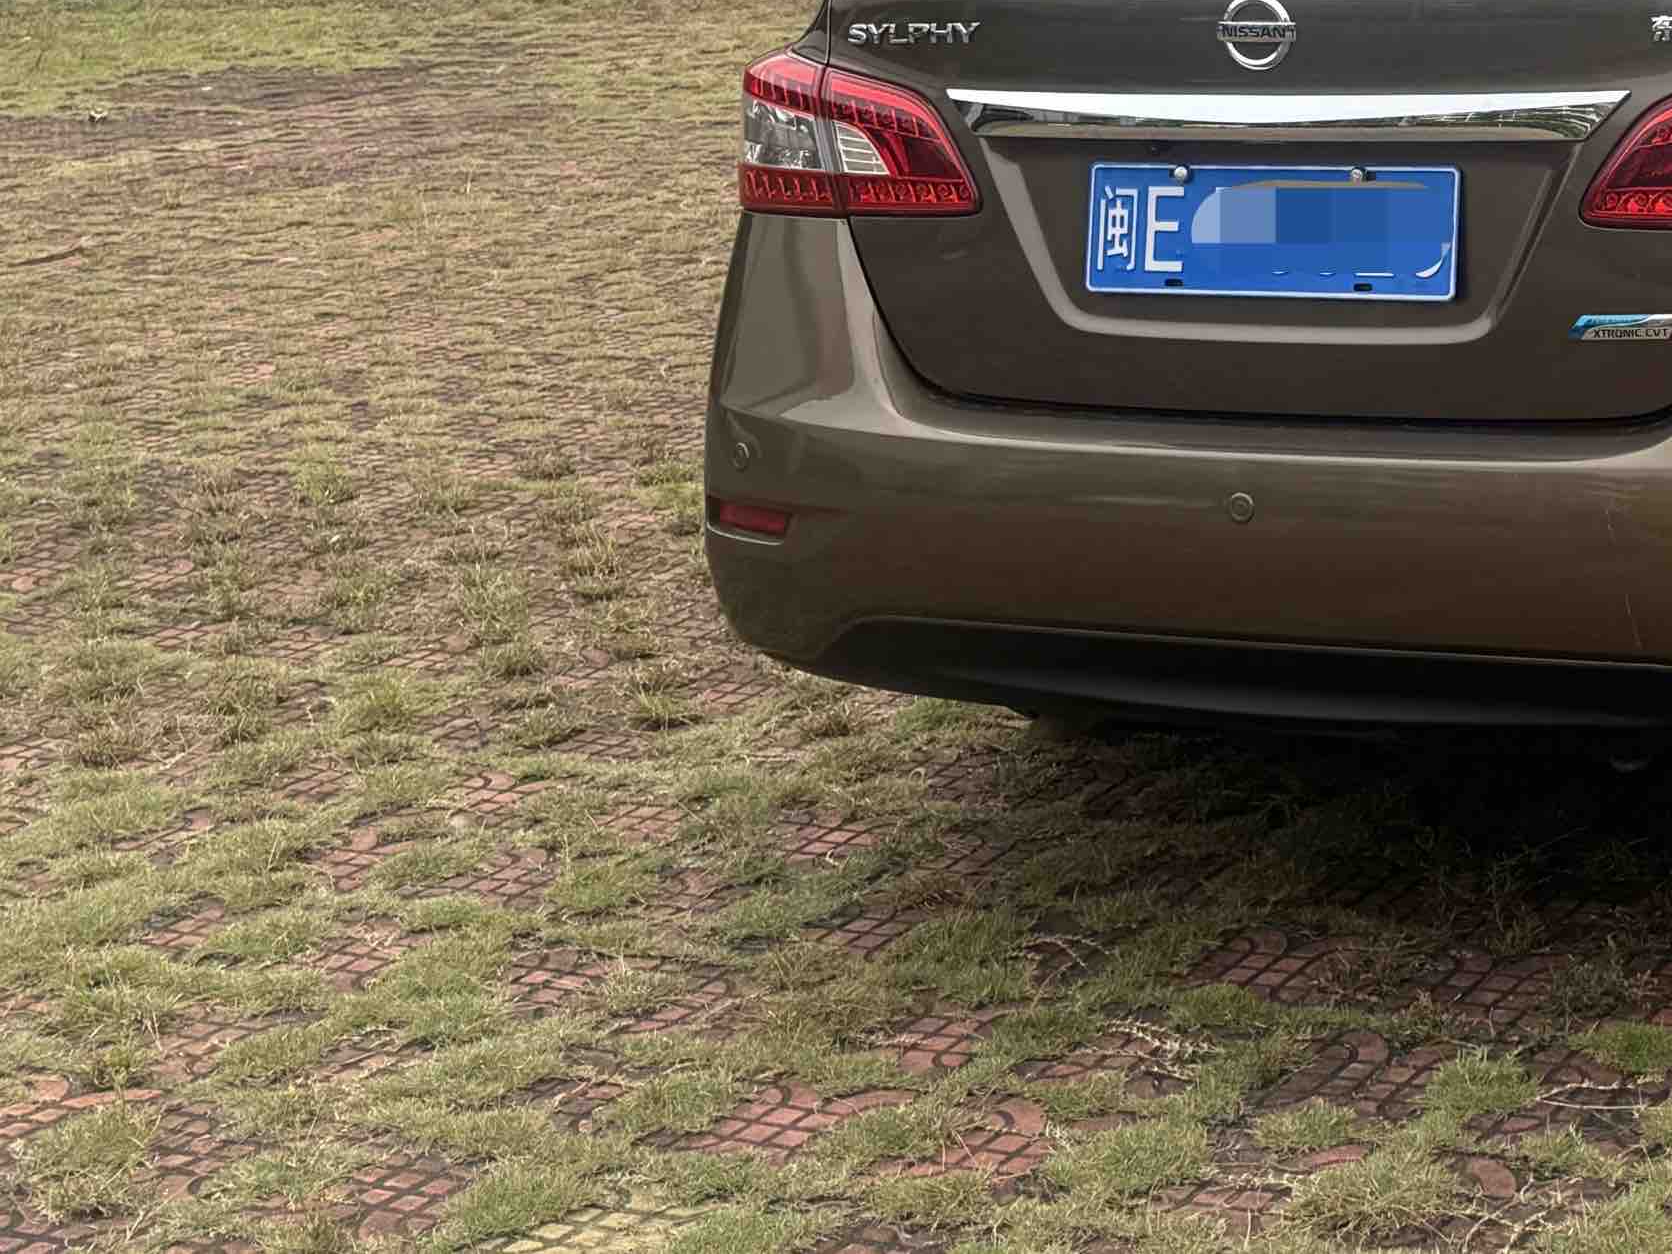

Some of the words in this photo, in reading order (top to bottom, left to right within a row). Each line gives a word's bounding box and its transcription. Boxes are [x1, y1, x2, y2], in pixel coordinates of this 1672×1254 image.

[847, 22, 981, 44] SYLPHY
[1221, 25, 1286, 38] NISSAN
[1593, 329, 1642, 339] XTRONIC
[1645, 329, 1668, 338] CVT
